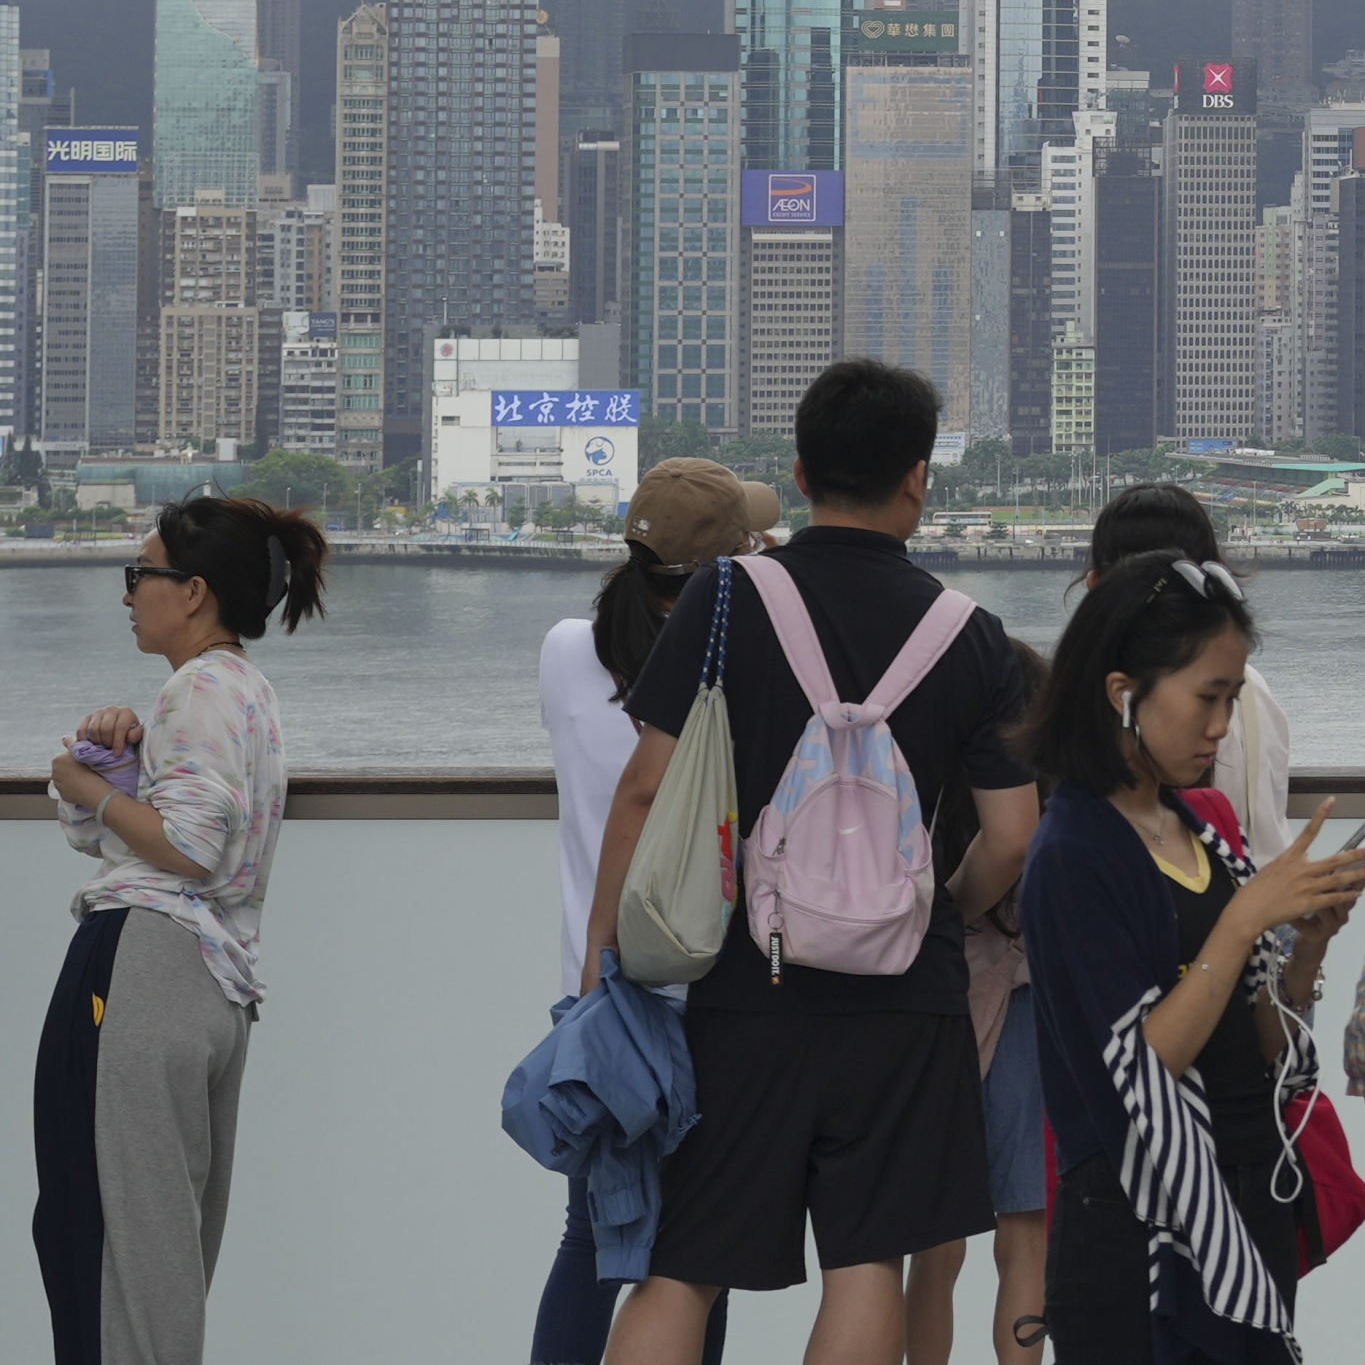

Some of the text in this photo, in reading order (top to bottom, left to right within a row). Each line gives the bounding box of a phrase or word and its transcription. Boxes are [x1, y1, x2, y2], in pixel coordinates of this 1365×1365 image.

[1202, 94, 1234, 109] DBS
[47, 139, 138, 162] 光明国际
[494, 392, 638, 424] 北京控股
[586, 468, 613, 477] SPCA
[771, 936, 780, 954] JUST
